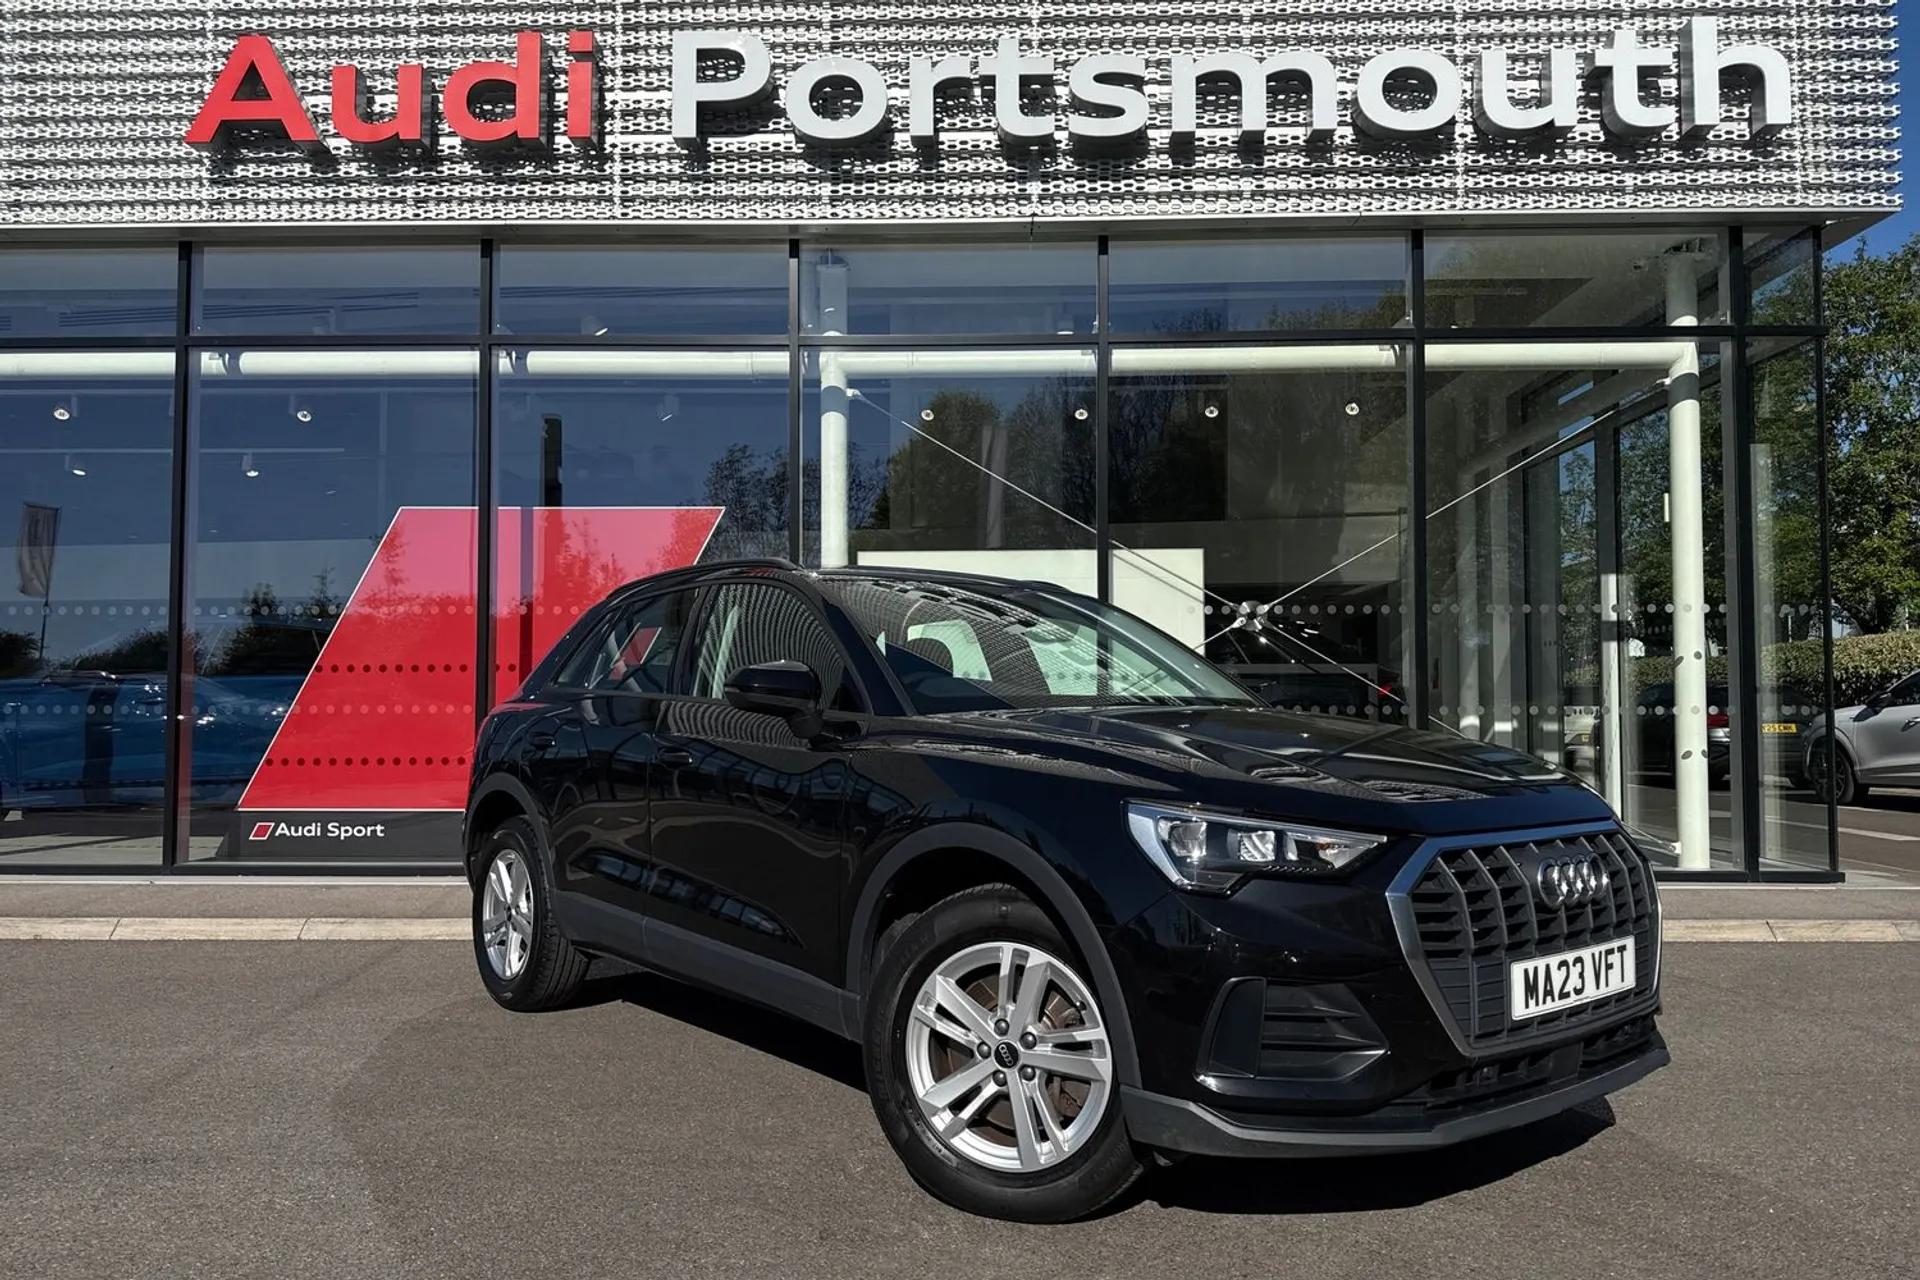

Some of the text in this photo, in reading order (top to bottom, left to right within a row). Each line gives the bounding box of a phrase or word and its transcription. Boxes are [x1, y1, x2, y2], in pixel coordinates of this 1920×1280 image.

[184, 16, 1793, 144] Audi Portsmouth
[274, 821, 386, 841] Audi Sport
[1523, 943, 1628, 1010] MA23 VFT
